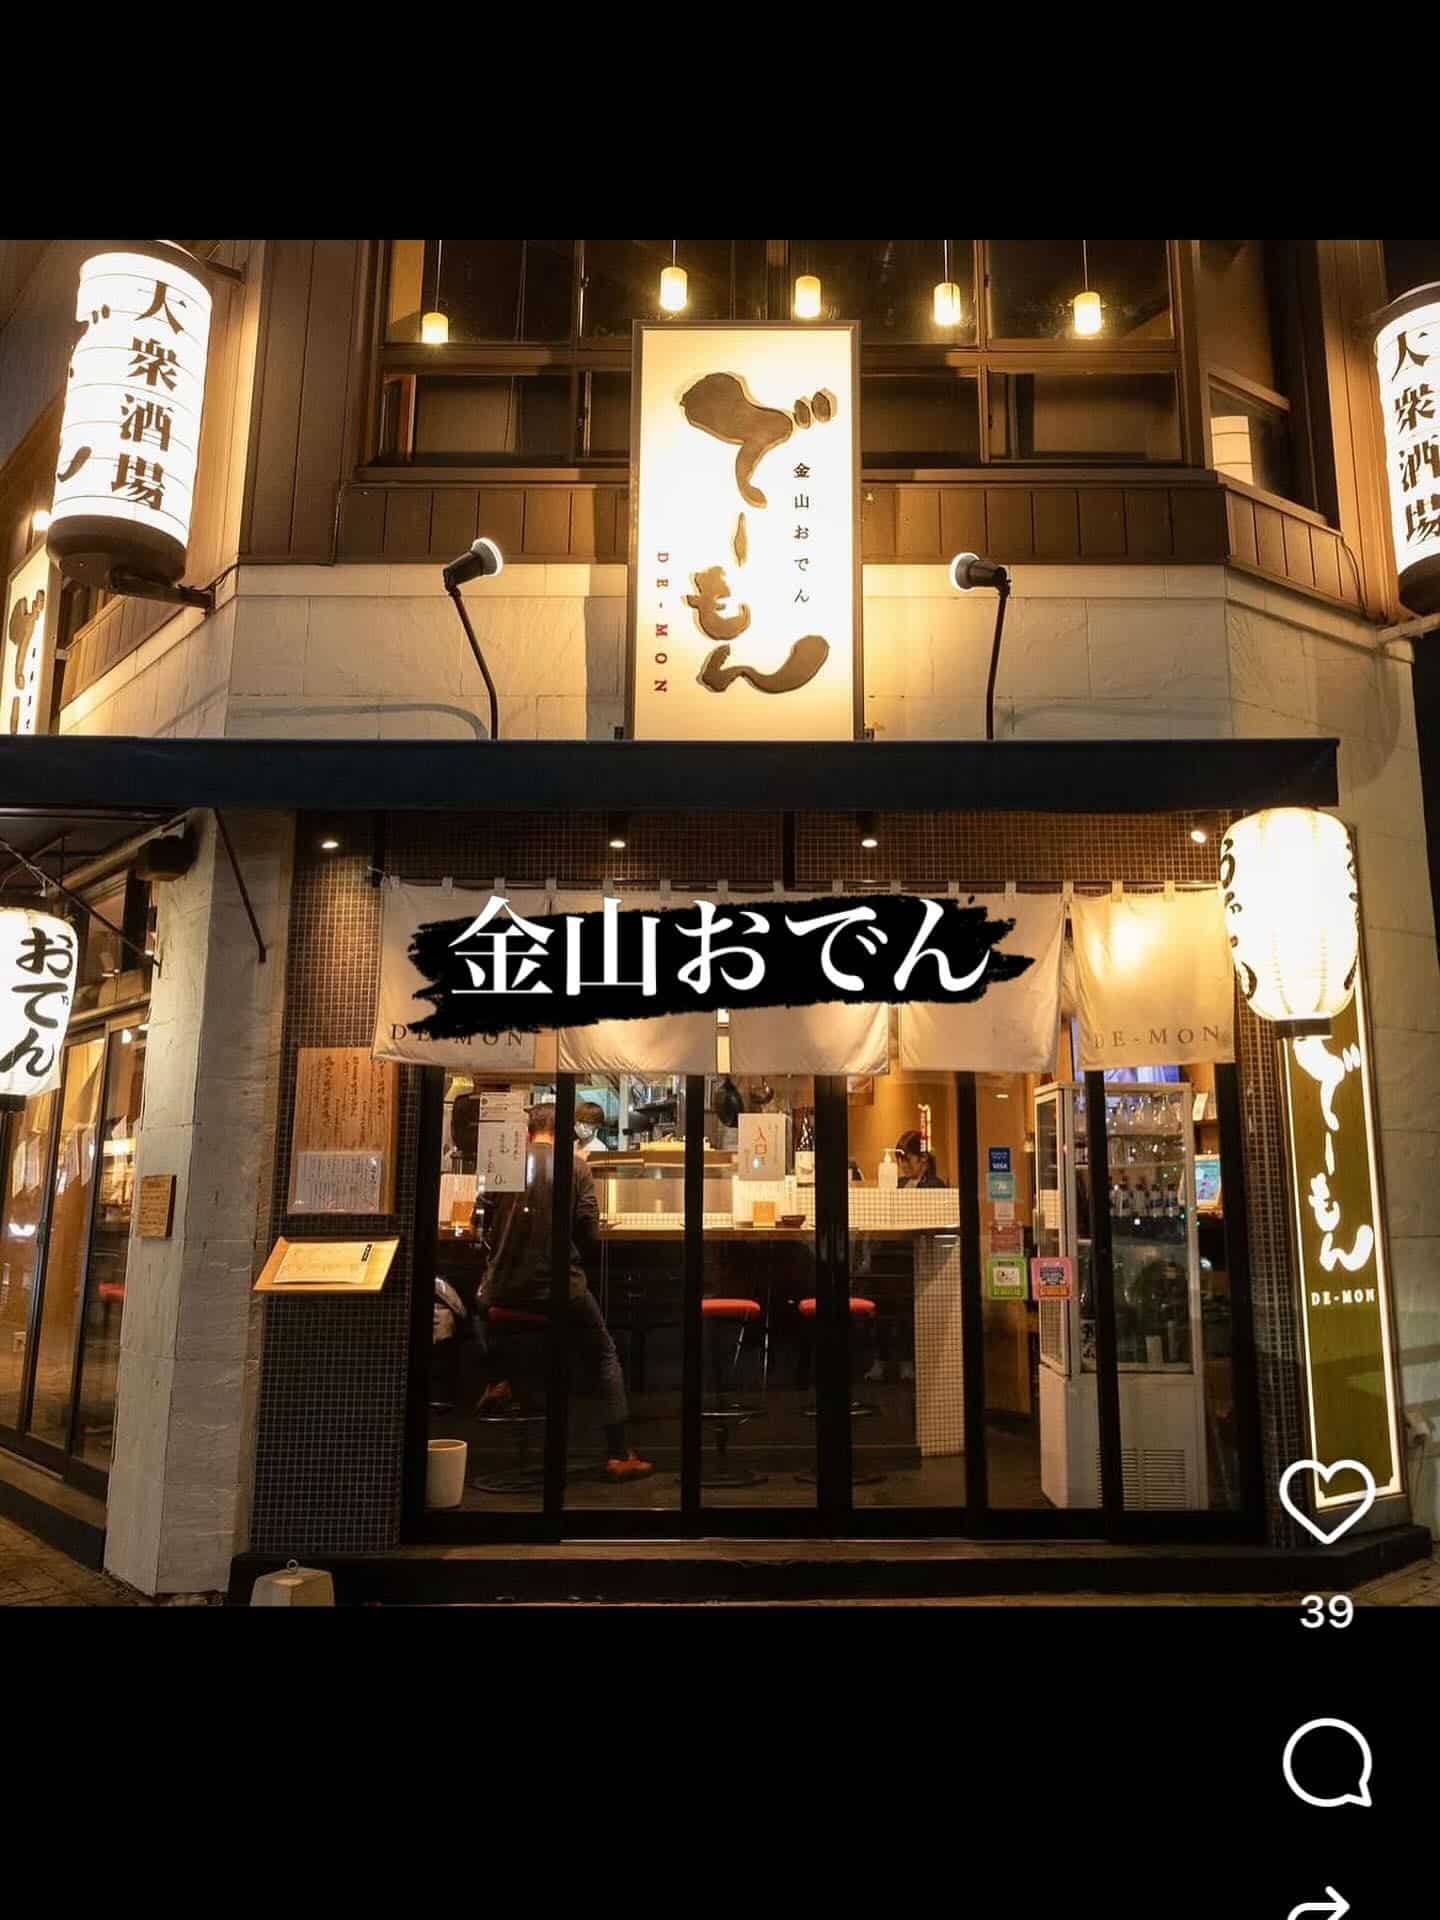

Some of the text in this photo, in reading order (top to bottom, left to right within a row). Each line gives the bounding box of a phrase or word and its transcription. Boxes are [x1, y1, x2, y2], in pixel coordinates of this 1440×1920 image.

[793, 462, 811, 604] 金山おでん
[654, 551, 669, 693] DE-MON
[0, 926, 74, 1078] おでん
[1094, 1024, 1220, 1049] DE-MON
[1311, 1287, 1376, 1306] DE-MON
